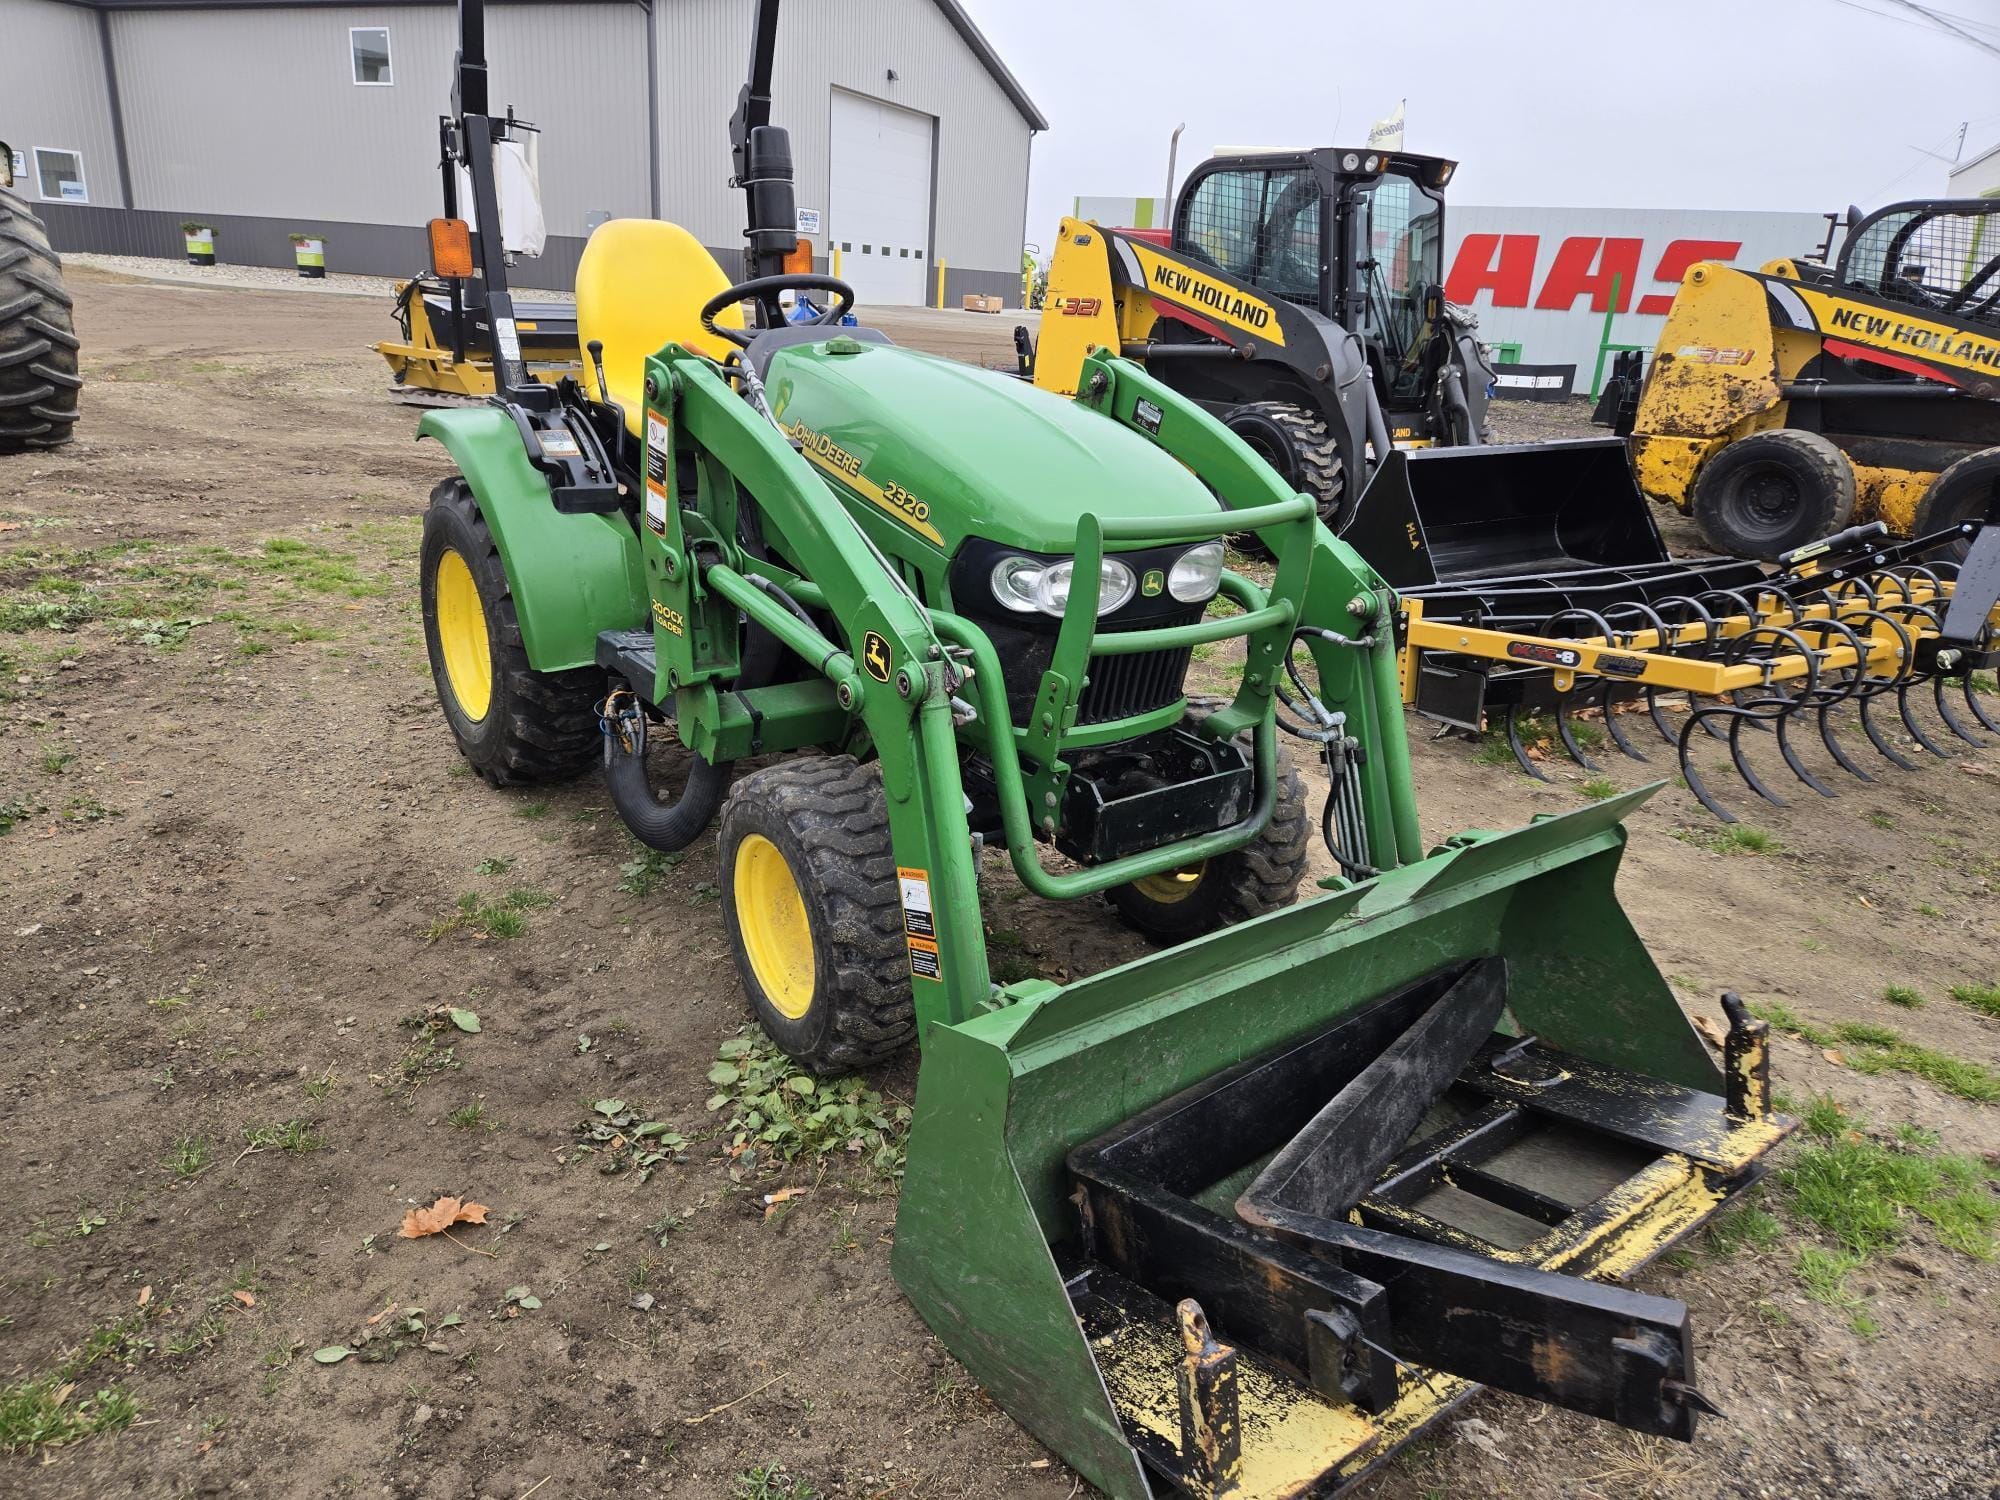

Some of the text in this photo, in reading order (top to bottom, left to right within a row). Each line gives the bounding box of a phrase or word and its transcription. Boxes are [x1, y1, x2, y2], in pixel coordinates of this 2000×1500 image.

[1055, 297, 1102, 317] L 321
[1154, 264, 1269, 328] NEW HOLLAND
[1831, 308, 1890, 336] NEW
[788, 418, 862, 477] JOHN DEERE
[883, 480, 930, 522] 2320
[652, 598, 684, 627] 200CX
[655, 613, 683, 637] LOADER
